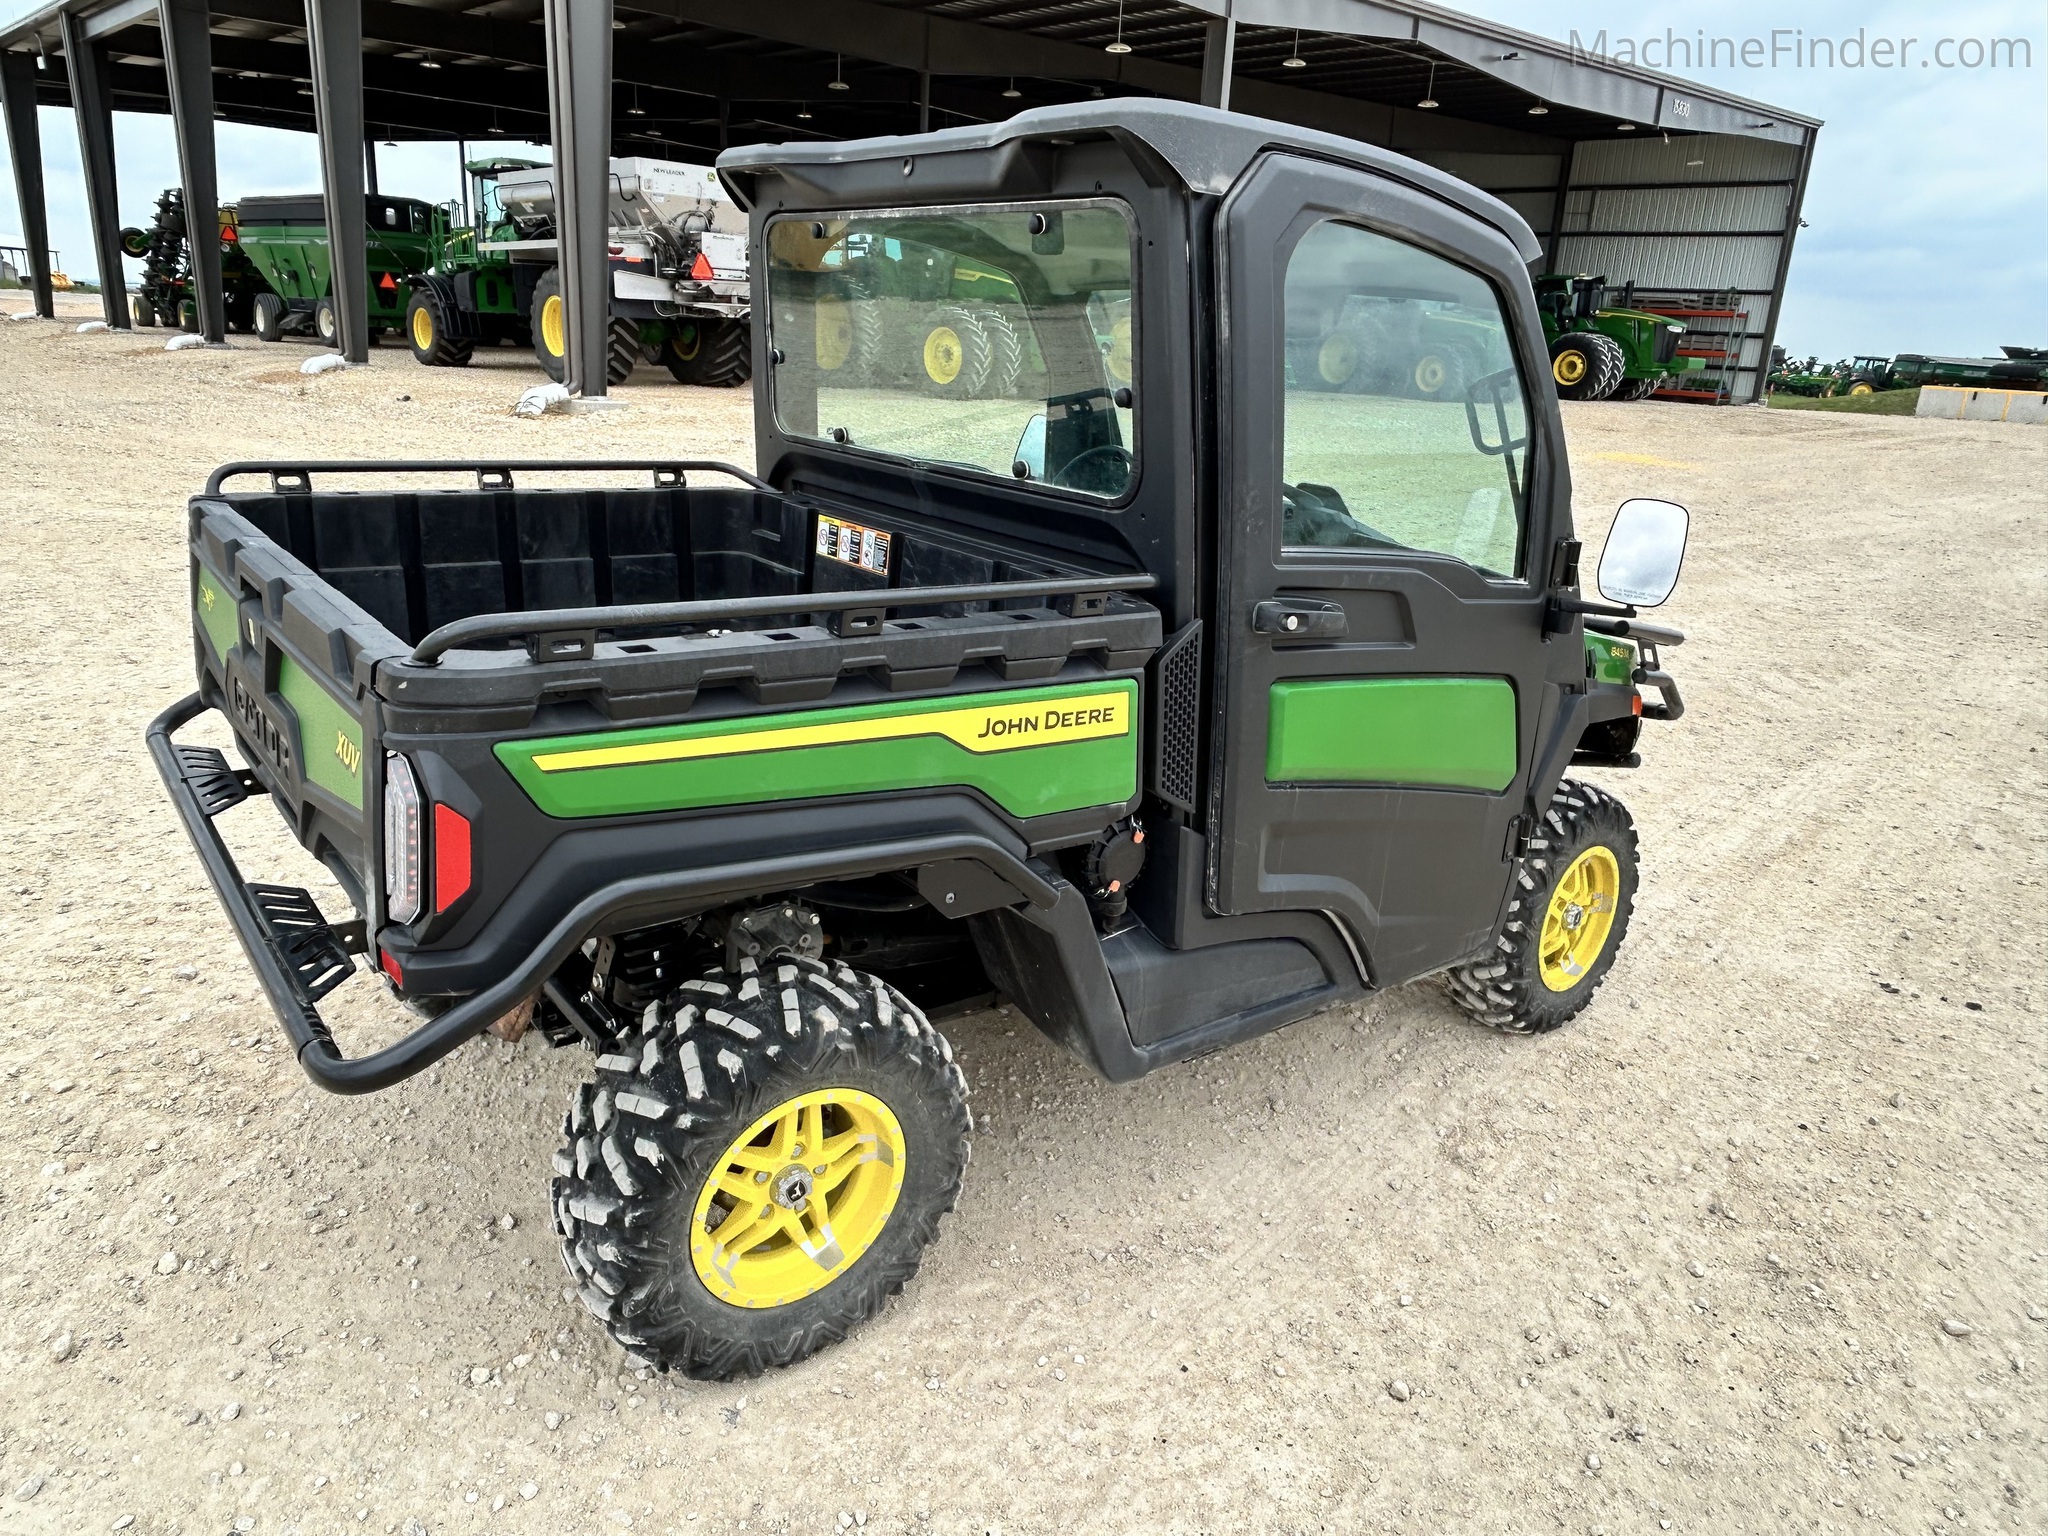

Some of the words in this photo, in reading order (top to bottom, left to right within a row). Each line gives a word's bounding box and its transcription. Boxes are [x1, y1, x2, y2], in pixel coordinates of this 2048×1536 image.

[977, 715, 1039, 738] JOHN
[1044, 706, 1115, 730] DEERE
[335, 729, 362, 776] XUV
